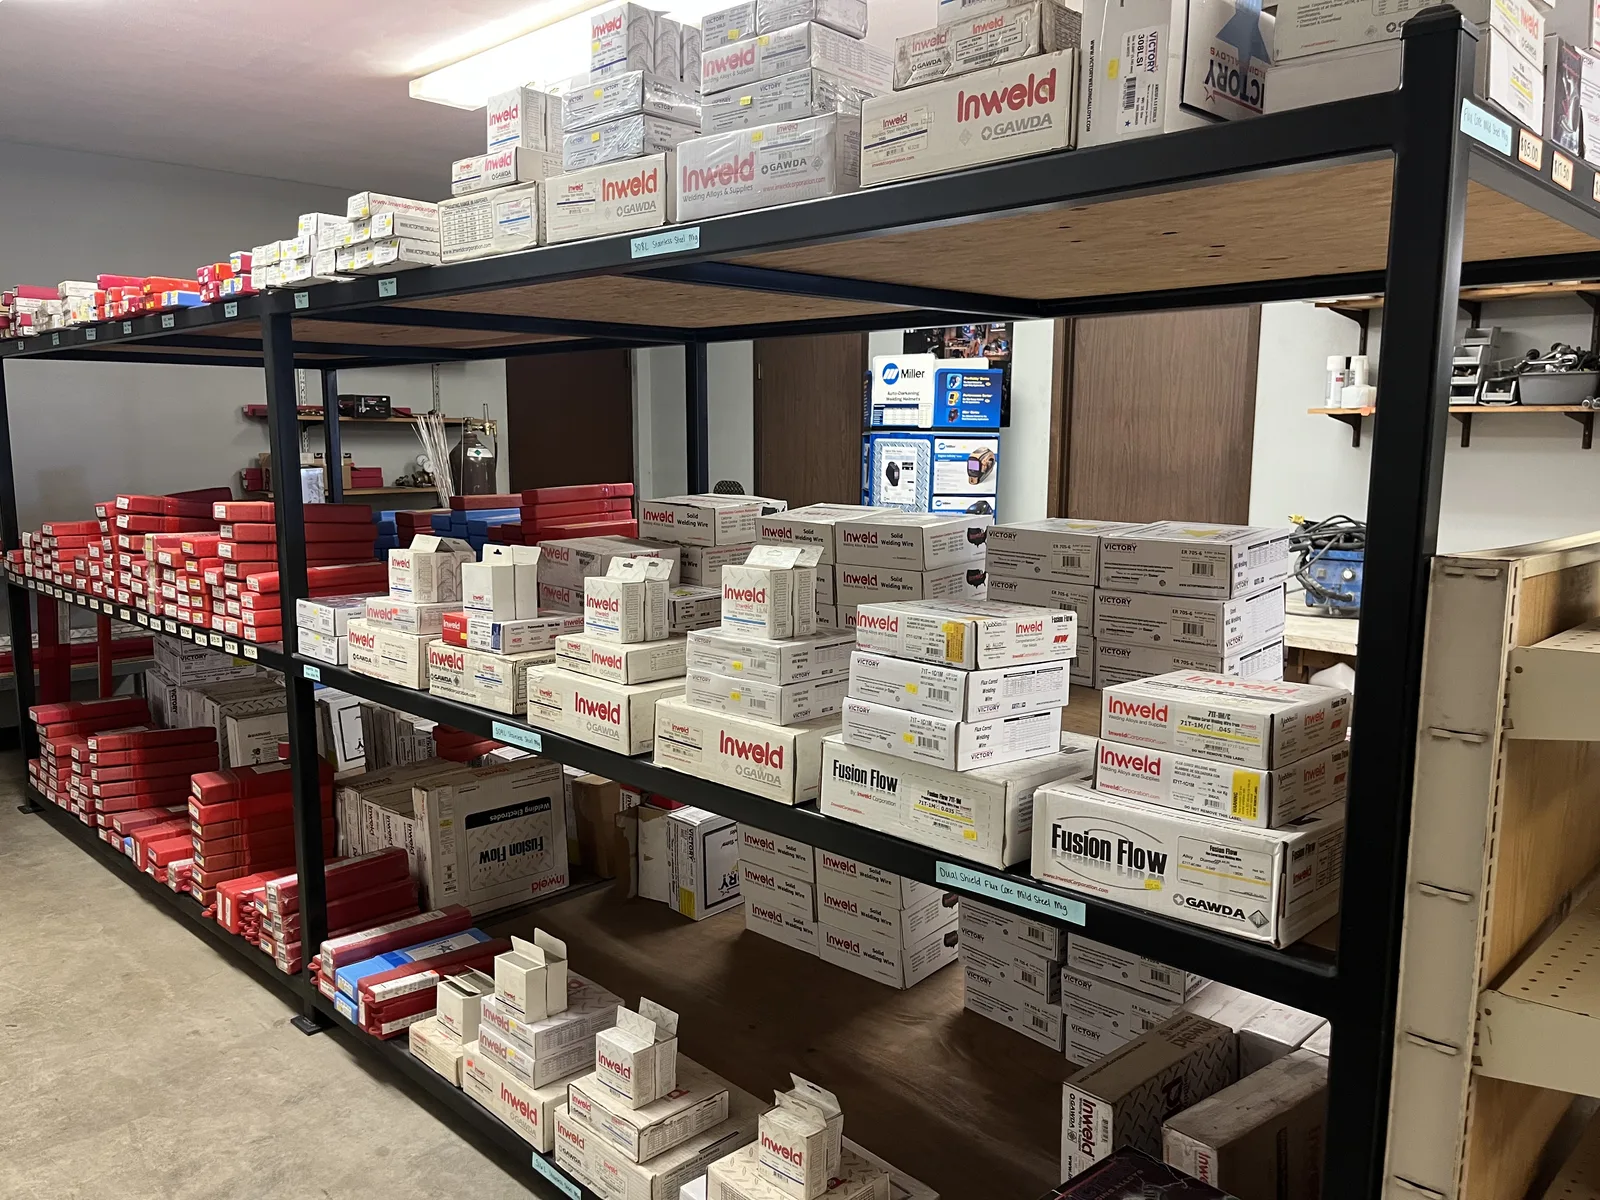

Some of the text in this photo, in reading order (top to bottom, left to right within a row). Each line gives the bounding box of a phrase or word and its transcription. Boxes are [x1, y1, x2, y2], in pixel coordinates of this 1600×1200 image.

[592, 16, 622, 38] Inweld
[972, 16, 1004, 34] Inweld
[912, 32, 948, 52] Inweld
[1147, 31, 1158, 74] VICTORY
[704, 45, 755, 78] Inweld
[917, 58, 942, 70] GAWDA
[958, 68, 1056, 123] Inweld
[489, 105, 518, 126] Inweld
[882, 112, 908, 128] Inweld
[994, 113, 1053, 136] GAWDA
[484, 152, 512, 170] Inweld
[770, 157, 807, 172] GAWDA
[683, 152, 755, 193] Inweld
[602, 168, 658, 202] Inweld
[683, 190, 705, 202] Welding
[706, 187, 723, 198] Alloys
[730, 184, 754, 196] Supplies
[623, 200, 656, 214] GAWDA
[900, 368, 926, 378] Miller
[643, 508, 674, 524] Inweld
[677, 519, 696, 528] Welding
[762, 526, 792, 539] Inweld
[795, 534, 812, 543] Welding
[843, 530, 878, 544] Inweld
[881, 539, 902, 548] Welding
[1104, 543, 1137, 551] VICTORY
[392, 556, 410, 569] Inweld
[843, 572, 878, 586] Inweld
[881, 582, 901, 591] Welding
[724, 584, 766, 604] Inweld
[1099, 596, 1132, 605] VICTORY
[586, 595, 618, 612] Inweld
[366, 606, 392, 621] Inweld
[857, 612, 898, 632] Inweld
[443, 620, 460, 630] Inweld
[1016, 620, 1042, 634] Inweld
[348, 628, 376, 650] Inweld
[1100, 646, 1132, 656] VICTORY
[430, 648, 464, 672] Inweld
[592, 650, 622, 670] Inweld
[856, 658, 880, 668] VICTORY
[1185, 674, 1301, 696] Inweld
[574, 692, 621, 726] Inweld
[848, 704, 870, 714] VICTORY
[978, 704, 1000, 713] VICTORY
[1108, 696, 1168, 722] Inweld
[592, 722, 620, 738] GAWDA
[1108, 714, 1125, 722] Welding
[1126, 716, 1138, 725] Alloys
[1148, 720, 1166, 730] Supplies
[1180, 720, 1212, 730] 71T-1M/C
[720, 730, 784, 770] Inweld
[971, 751, 994, 760] VICTORY
[1100, 746, 1162, 776] Inweld
[744, 766, 782, 786] GAWDA
[833, 760, 898, 793] Fusion Flow
[1100, 766, 1117, 774] Welding
[1118, 769, 1131, 777] Alloys
[1140, 774, 1161, 783] Supplies
[857, 791, 872, 800] Inweld
[872, 794, 897, 807] Corporation
[490, 802, 550, 822] Welding Electrodes
[479, 836, 544, 864] Fusion Flow
[744, 832, 775, 851] Inweld
[786, 844, 797, 852] Solid
[1052, 824, 1112, 862] Fusion
[1116, 838, 1168, 875] Flow
[778, 848, 797, 860] Welding
[822, 854, 856, 875] Inweld
[869, 867, 882, 876] Solid
[531, 874, 565, 893] Inweld
[744, 868, 775, 888] Inweld
[785, 882, 796, 890] Solid
[860, 872, 880, 884] Welding
[1042, 872, 1109, 894] www.InweldCorporation.com
[777, 886, 796, 898] Welding
[940, 866, 958, 880] Dual
[960, 872, 982, 886] Shield
[984, 880, 998, 891] Flux
[1017, 890, 1032, 902] Mild
[1034, 896, 1051, 908] Steel
[1054, 901, 1068, 916] Mig
[824, 892, 858, 914] Inweld
[870, 907, 882, 916] Solid
[1186, 897, 1246, 920] GAWDA
[752, 904, 783, 924] Inweld
[793, 918, 804, 926] Solid
[860, 912, 892, 927] Welding Wire
[785, 922, 803, 934] Welding
[961, 928, 985, 943] VICTORY
[826, 932, 860, 954] Inweld
[863, 952, 894, 968] Welding Wire
[872, 948, 884, 956] Solid
[966, 970, 992, 986] VICTORY
[1063, 974, 1093, 990] VICTORY
[483, 1002, 510, 1032] Inweld
[1071, 1024, 1101, 1040] VICTORY
[480, 1030, 506, 1060] Inweld
[598, 1050, 631, 1080] Inweld
[500, 1082, 538, 1126] Inweld
[572, 1094, 592, 1112] Inweld
[557, 1121, 585, 1150] Inweld
[1082, 1098, 1096, 1158] Inweld
[761, 1132, 803, 1166] Inweld
